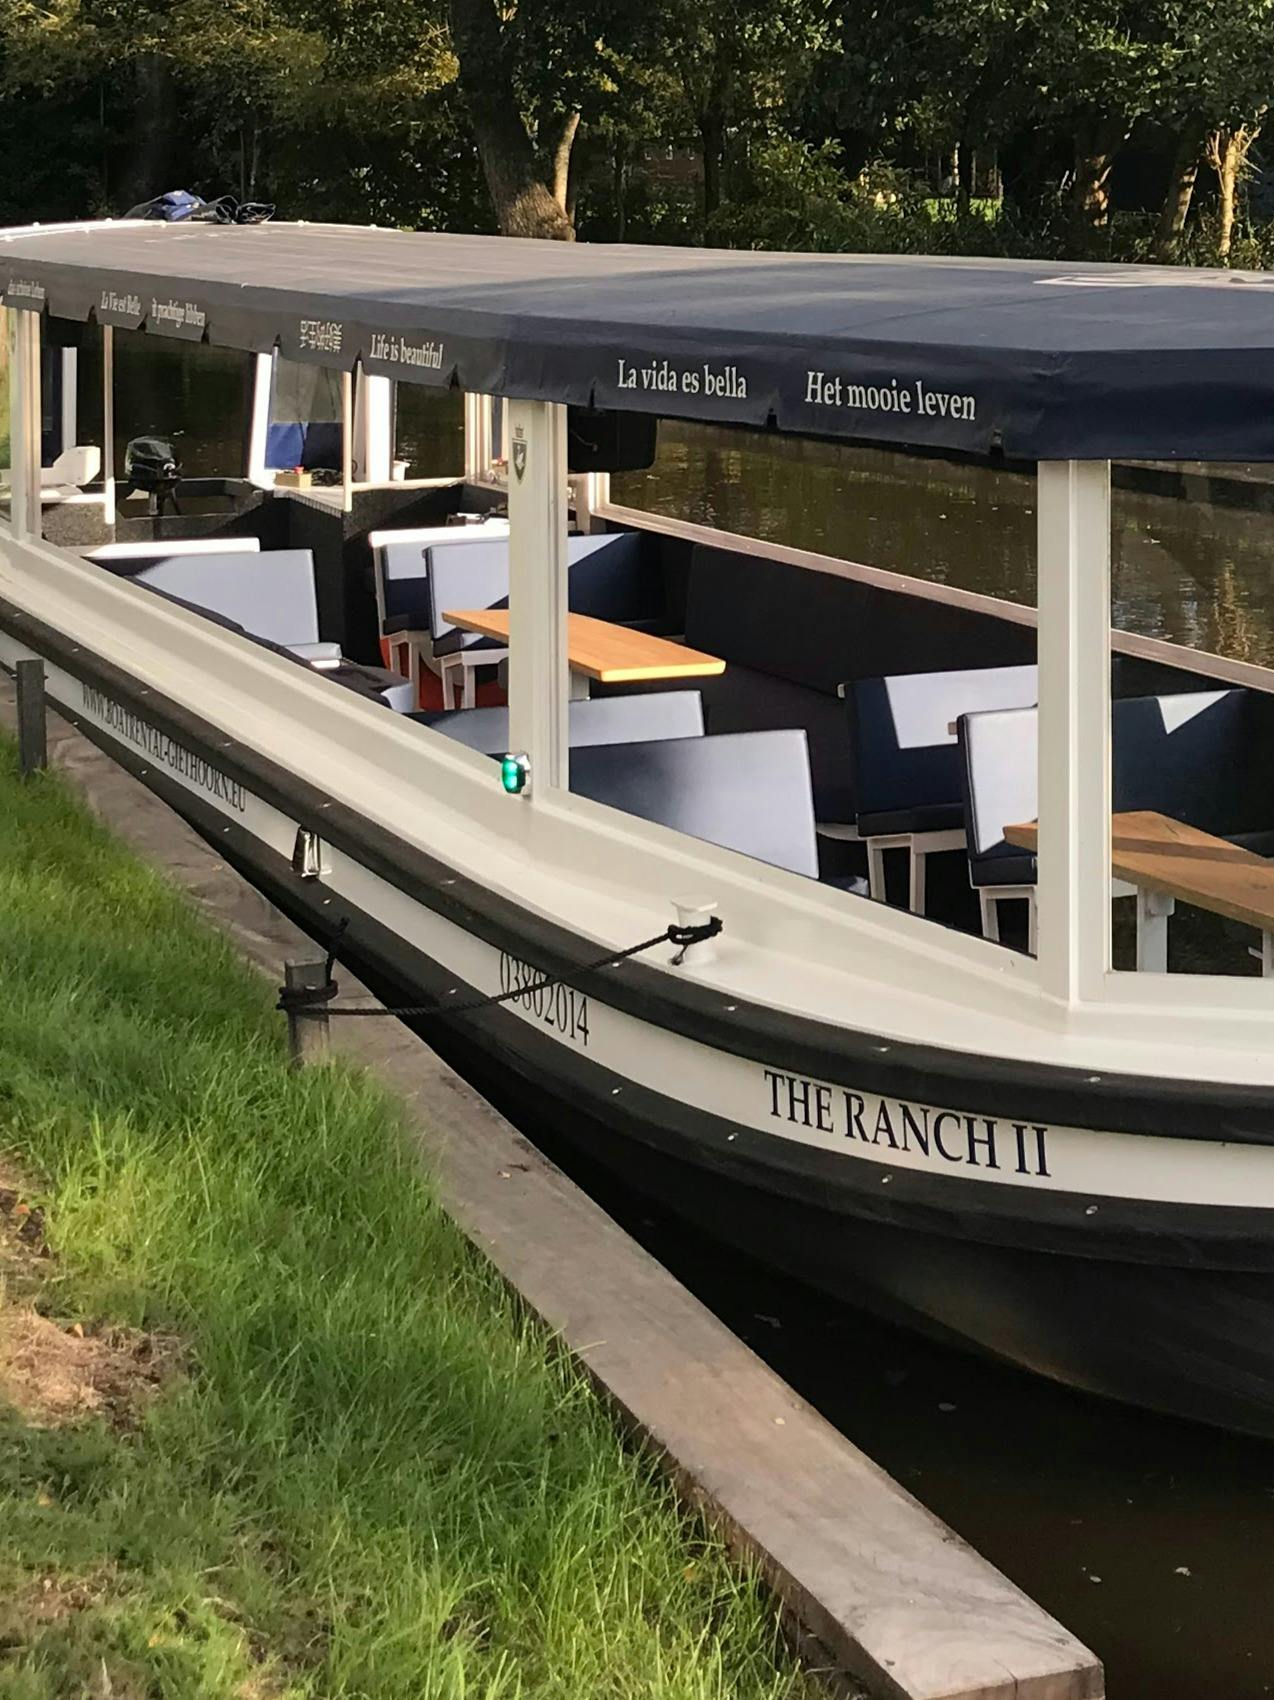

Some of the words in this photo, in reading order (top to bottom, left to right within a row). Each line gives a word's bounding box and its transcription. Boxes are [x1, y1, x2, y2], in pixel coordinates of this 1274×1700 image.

[369, 333, 390, 360] Life
[389, 336, 399, 362] is
[400, 337, 444, 370] beautiful
[617, 359, 637, 389] La
[641, 360, 678, 392] vida
[681, 371, 700, 394] es
[703, 364, 747, 399] bella
[804, 371, 842, 406] Het
[847, 378, 912, 413] mooie
[915, 380, 977, 421] leven
[764, 1070, 834, 1134] THE
[842, 1091, 1001, 1170] RANCH
[1011, 1123, 1052, 1178] II
